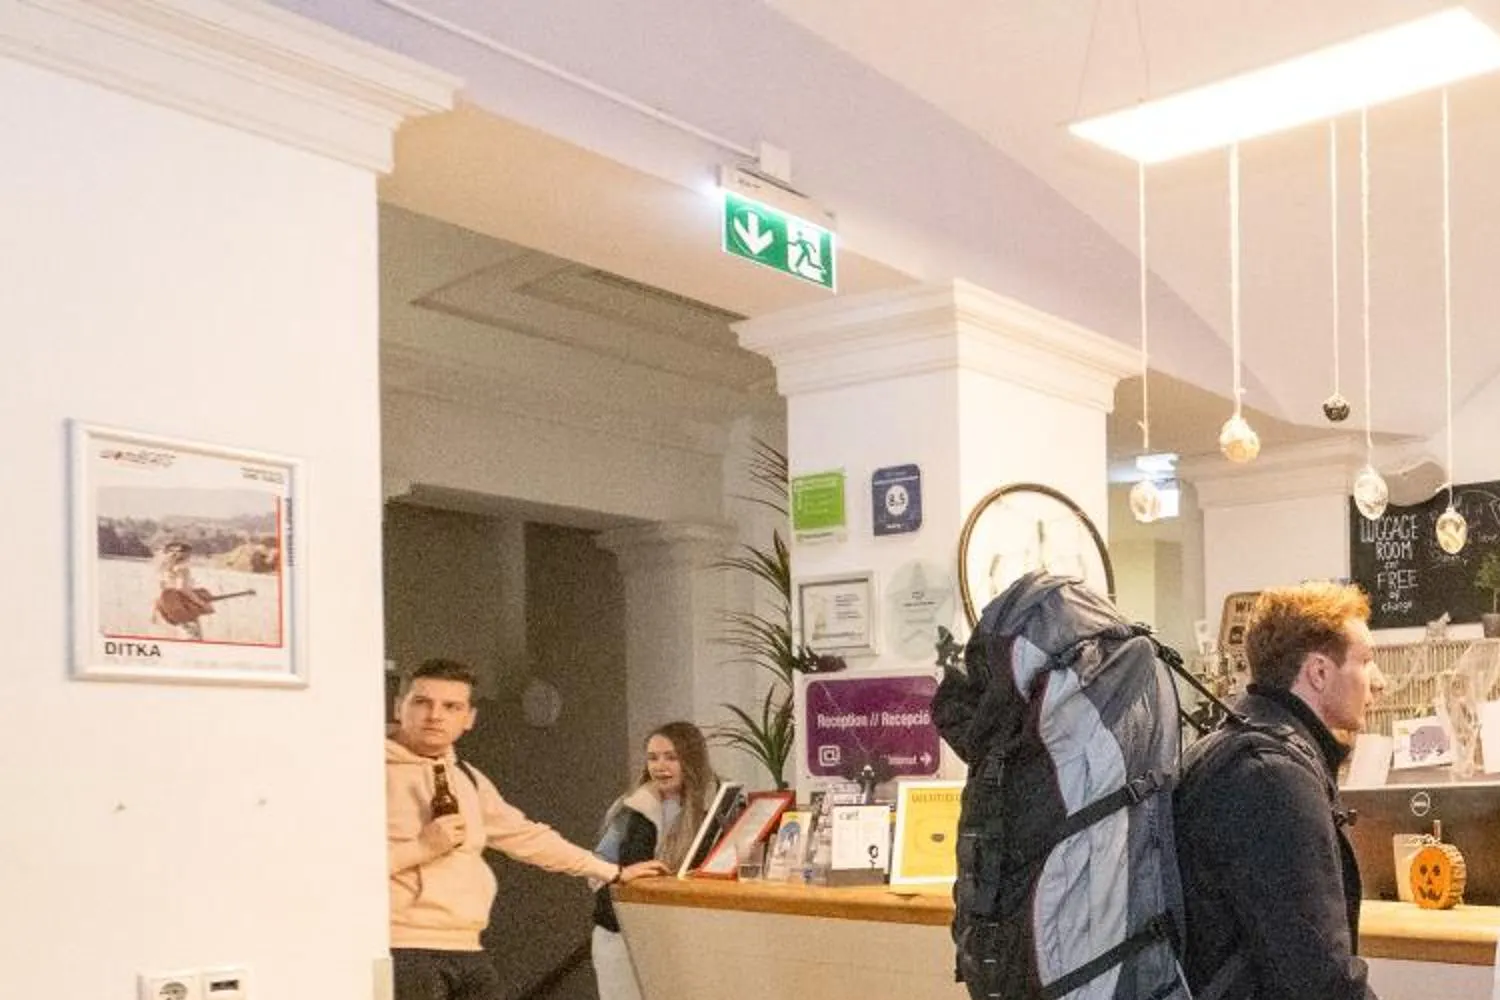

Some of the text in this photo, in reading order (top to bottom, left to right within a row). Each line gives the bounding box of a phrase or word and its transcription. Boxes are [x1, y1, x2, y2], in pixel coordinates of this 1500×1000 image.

[1360, 514, 1419, 543] LUGGAGE
[1375, 541, 1413, 561] ROOM
[1377, 569, 1419, 590] FREE
[105, 641, 162, 657] DITKA
[817, 711, 868, 731] Reception
